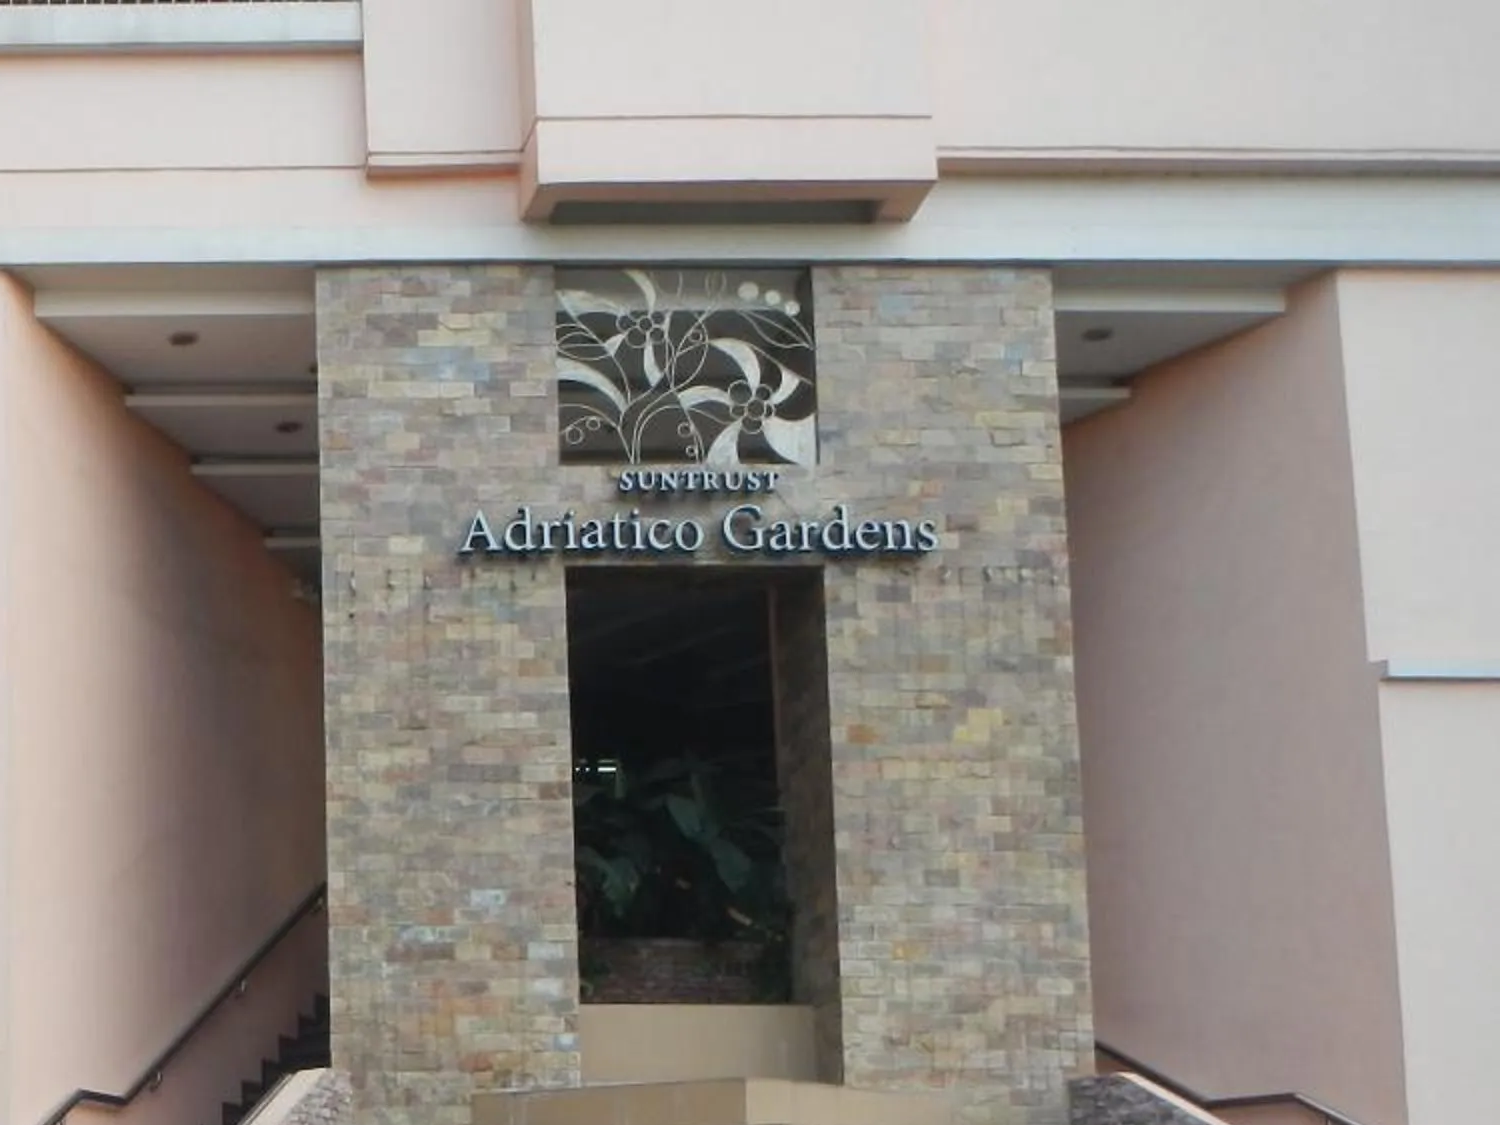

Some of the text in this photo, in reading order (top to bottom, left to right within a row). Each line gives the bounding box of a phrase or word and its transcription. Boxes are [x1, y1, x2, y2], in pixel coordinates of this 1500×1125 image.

[618, 470, 781, 492] SUNTRUST
[459, 504, 939, 555] Adriatico Gardens
